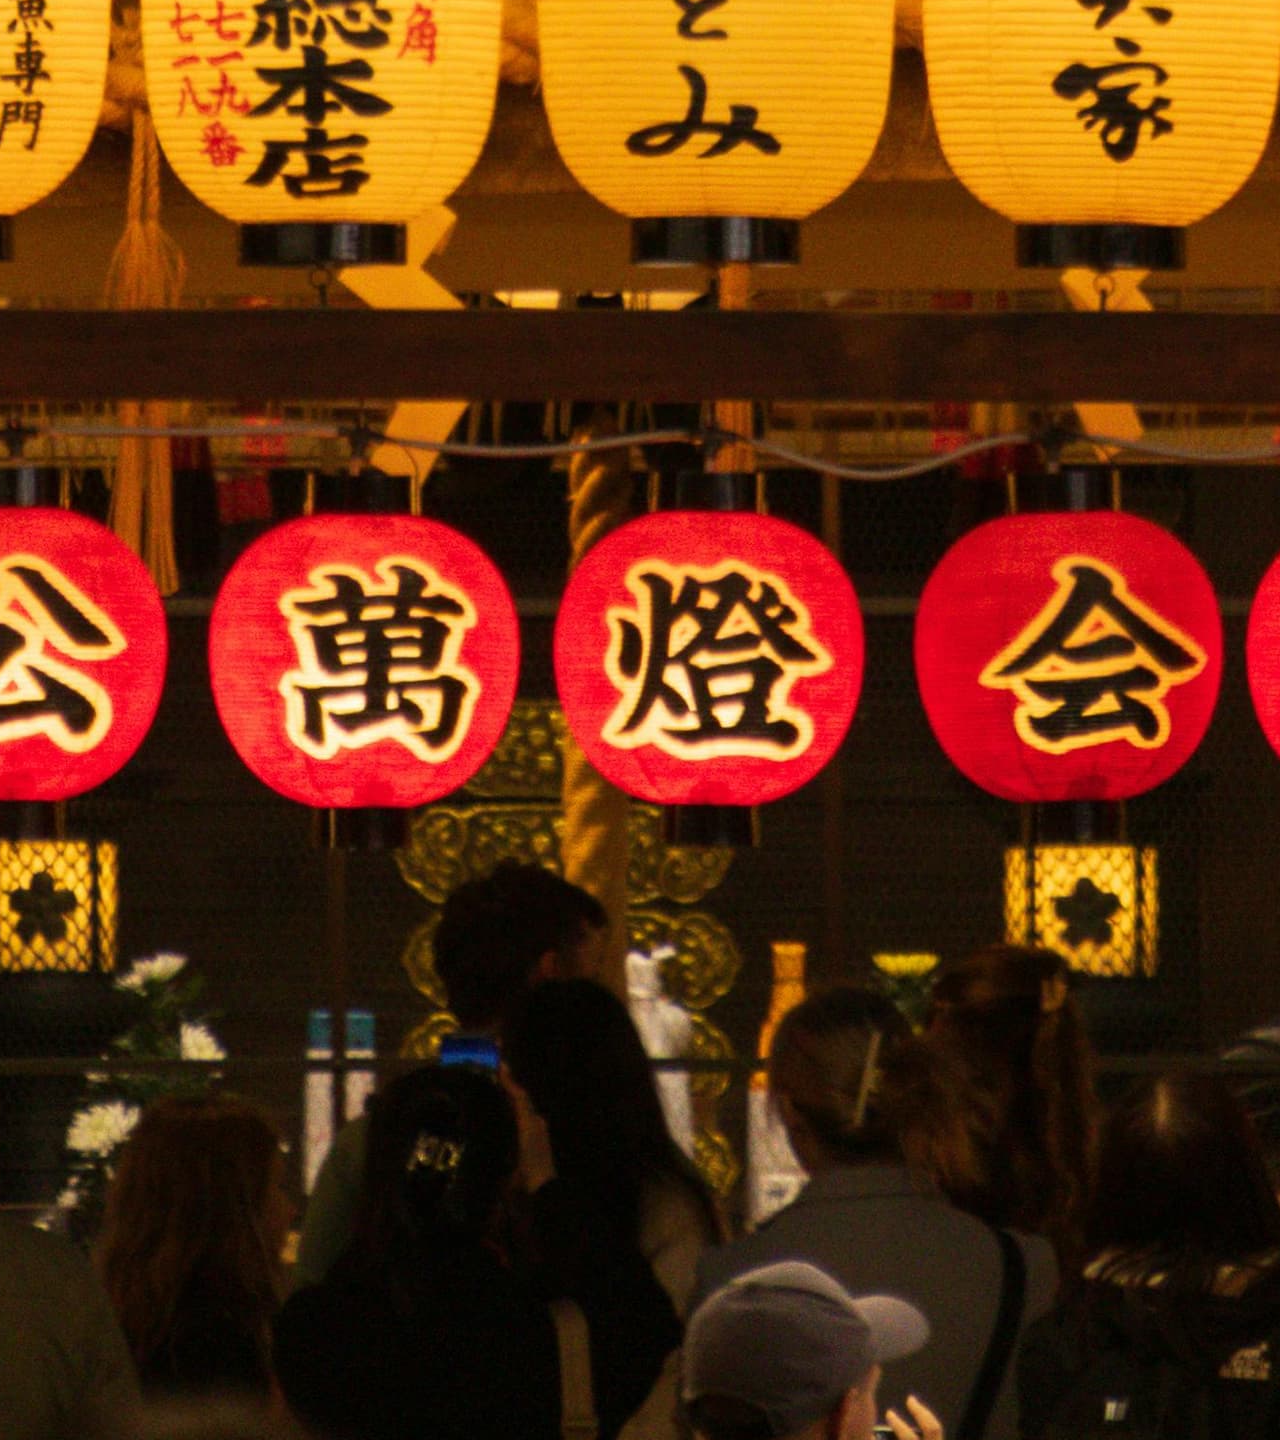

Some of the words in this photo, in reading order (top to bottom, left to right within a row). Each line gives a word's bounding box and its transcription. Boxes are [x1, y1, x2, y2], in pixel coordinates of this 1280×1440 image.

[290, 568, 469, 756] 萬
[611, 570, 826, 754] 燈
[989, 564, 1202, 746] 会
